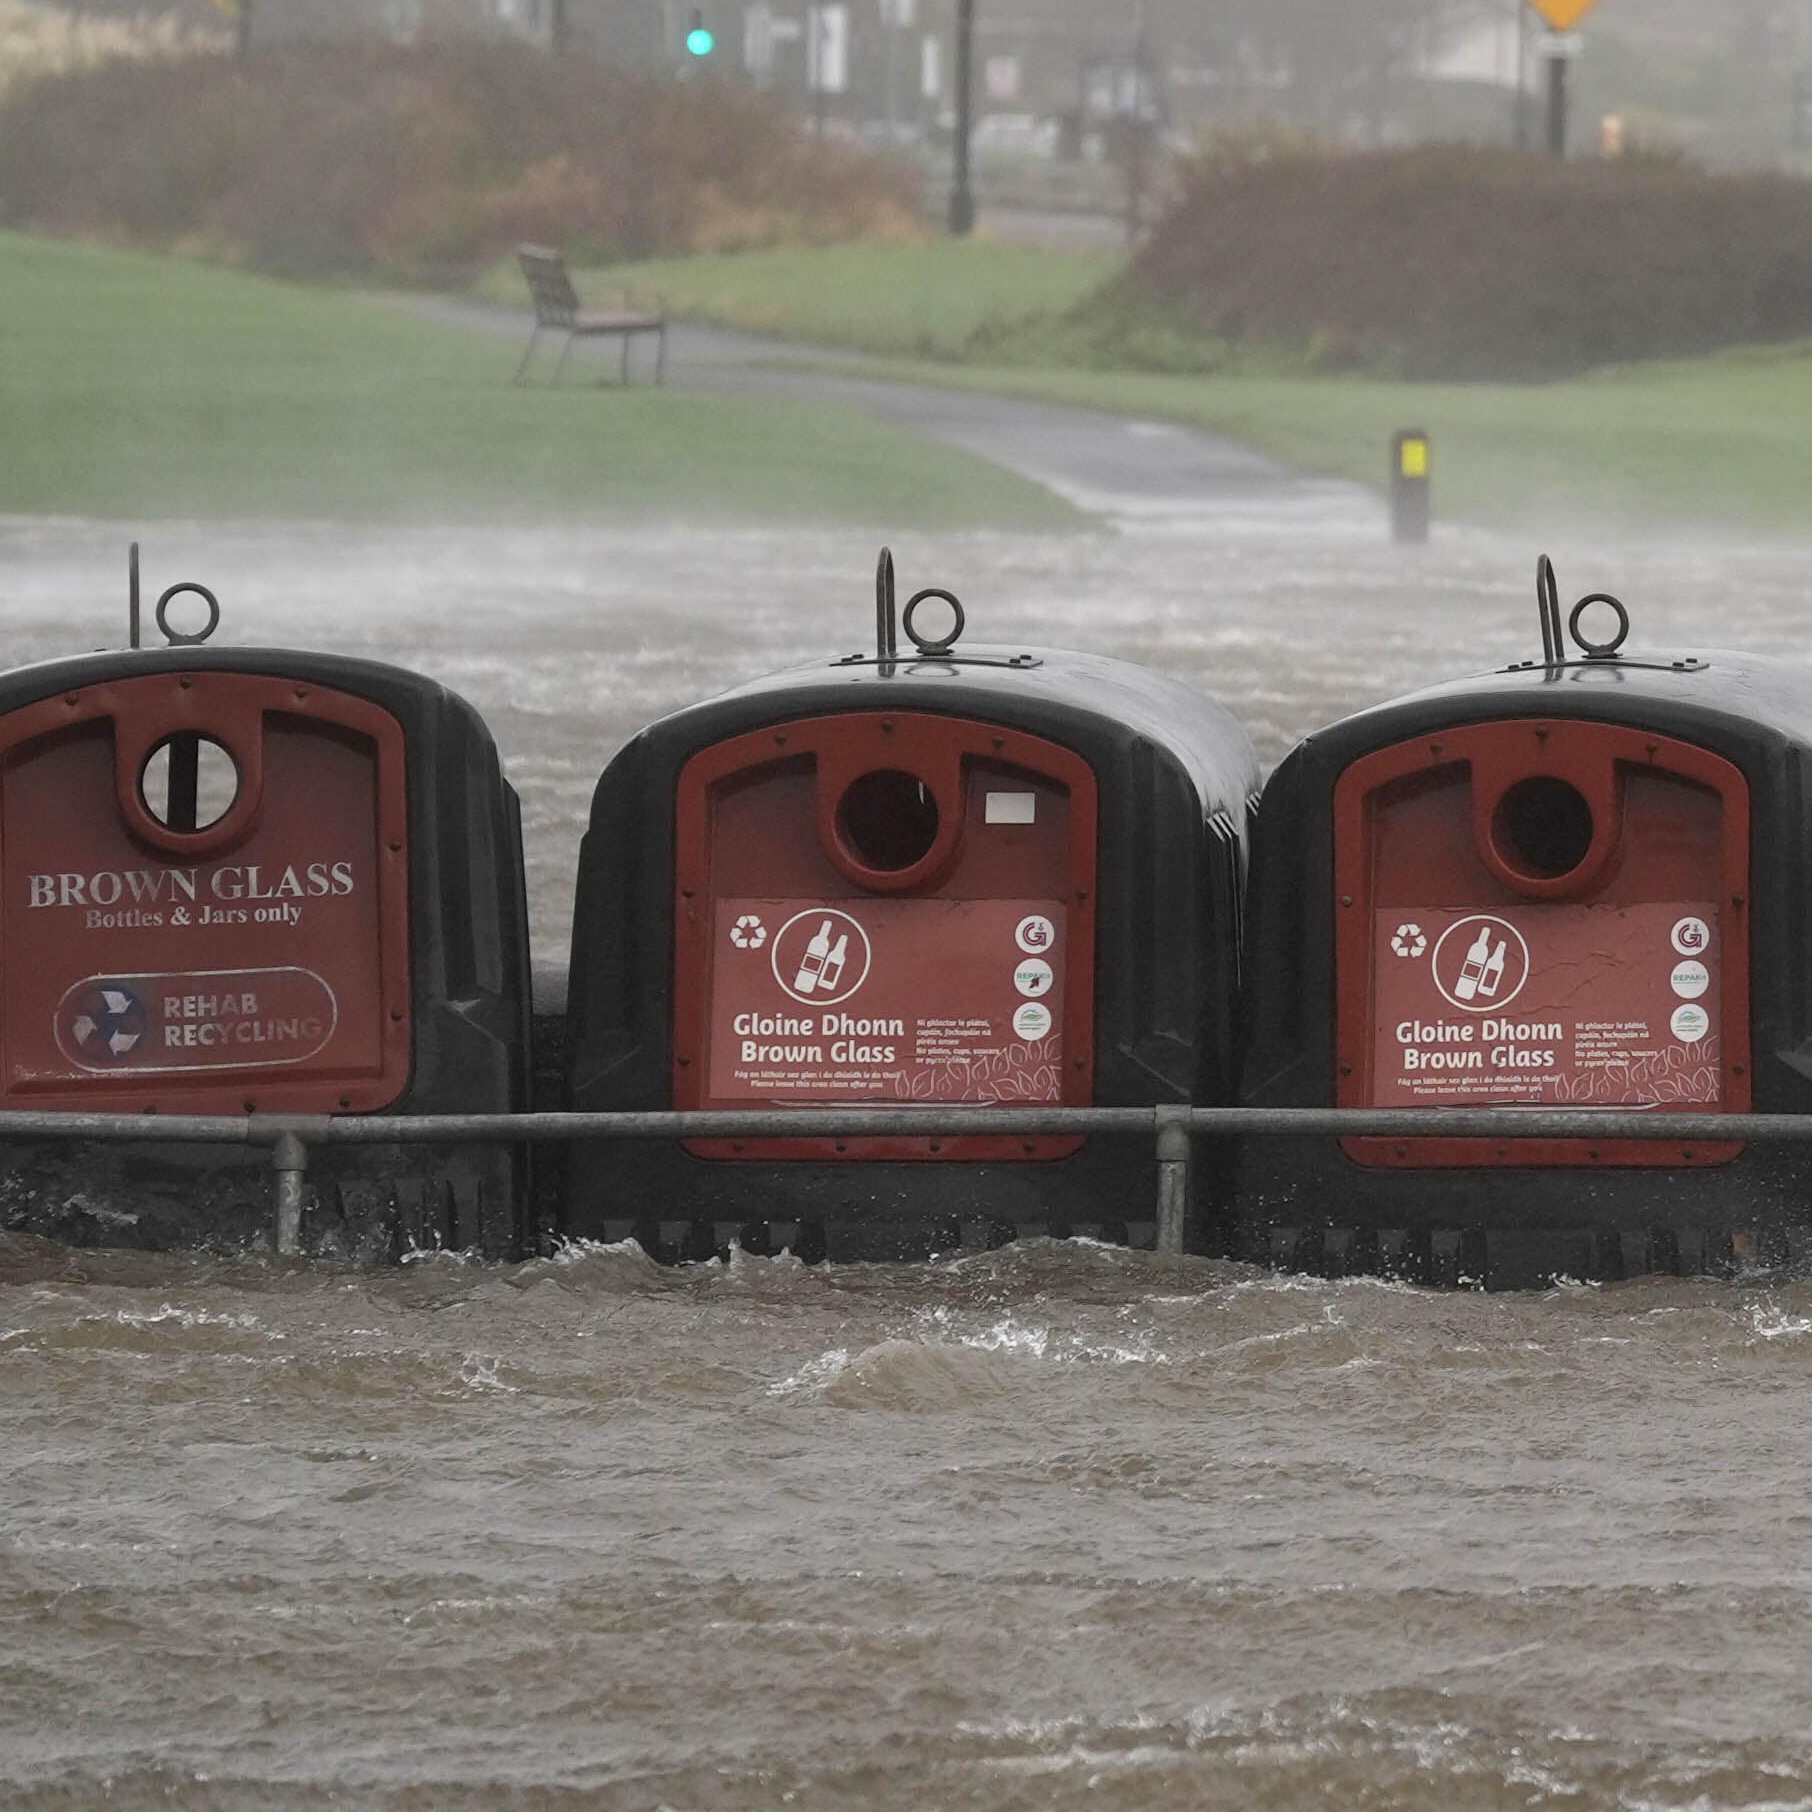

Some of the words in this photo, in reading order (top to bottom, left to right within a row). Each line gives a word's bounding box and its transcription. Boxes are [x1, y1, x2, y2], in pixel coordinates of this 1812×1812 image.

[27, 868, 198, 908] BROWN
[211, 862, 354, 900] GLASS
[86, 908, 163, 929] Bottles
[170, 906, 191, 925] &
[199, 905, 247, 925] Jars
[254, 902, 303, 926] only
[163, 993, 258, 1018] REHAB
[164, 1017, 322, 1047] RECYCLING
[733, 1012, 814, 1036] Gloine
[821, 1013, 904, 1036] Dhonn
[1396, 1019, 1474, 1043] Gloine
[1481, 1018, 1563, 1041] Dhonn
[741, 1040, 823, 1062] Brown
[830, 1040, 895, 1063] Glass
[1404, 1048, 1483, 1070] Brown
[1491, 1044, 1555, 1068] Glass
